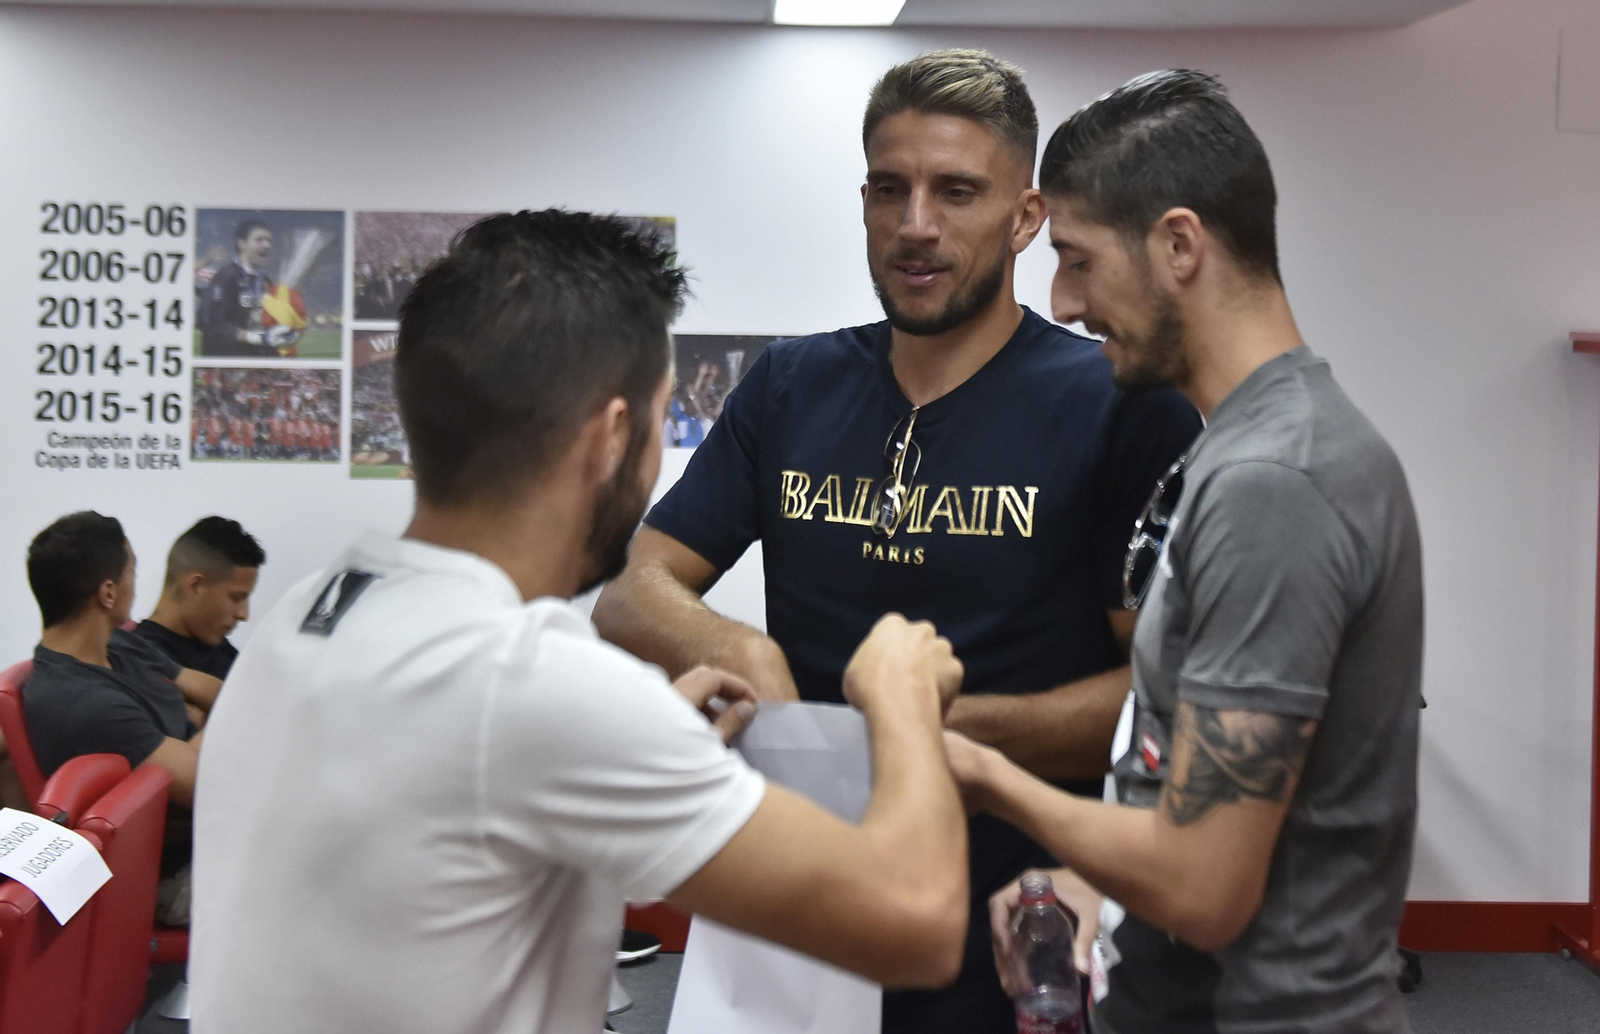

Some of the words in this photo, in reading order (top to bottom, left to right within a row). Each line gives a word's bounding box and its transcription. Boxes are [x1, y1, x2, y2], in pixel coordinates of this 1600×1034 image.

[40, 202, 187, 238] 2005-06
[39, 249, 186, 283] 2006-07
[38, 297, 184, 330] 2013-14
[36, 343, 183, 377] 2014-15
[35, 390, 182, 423] 2015-16
[47, 431, 132, 453] Campeón
[138, 433, 160, 449] de
[165, 434, 181, 450] la
[34, 450, 81, 471] Copa
[86, 452, 109, 468] de
[114, 453, 130, 469] la
[136, 453, 181, 470] UEFA
[780, 470, 1039, 537] BALMAIN
[862, 540, 925, 565] PARIS
[0, 821, 39, 858] SERVADO
[20, 836, 74, 878] JUGADORES
